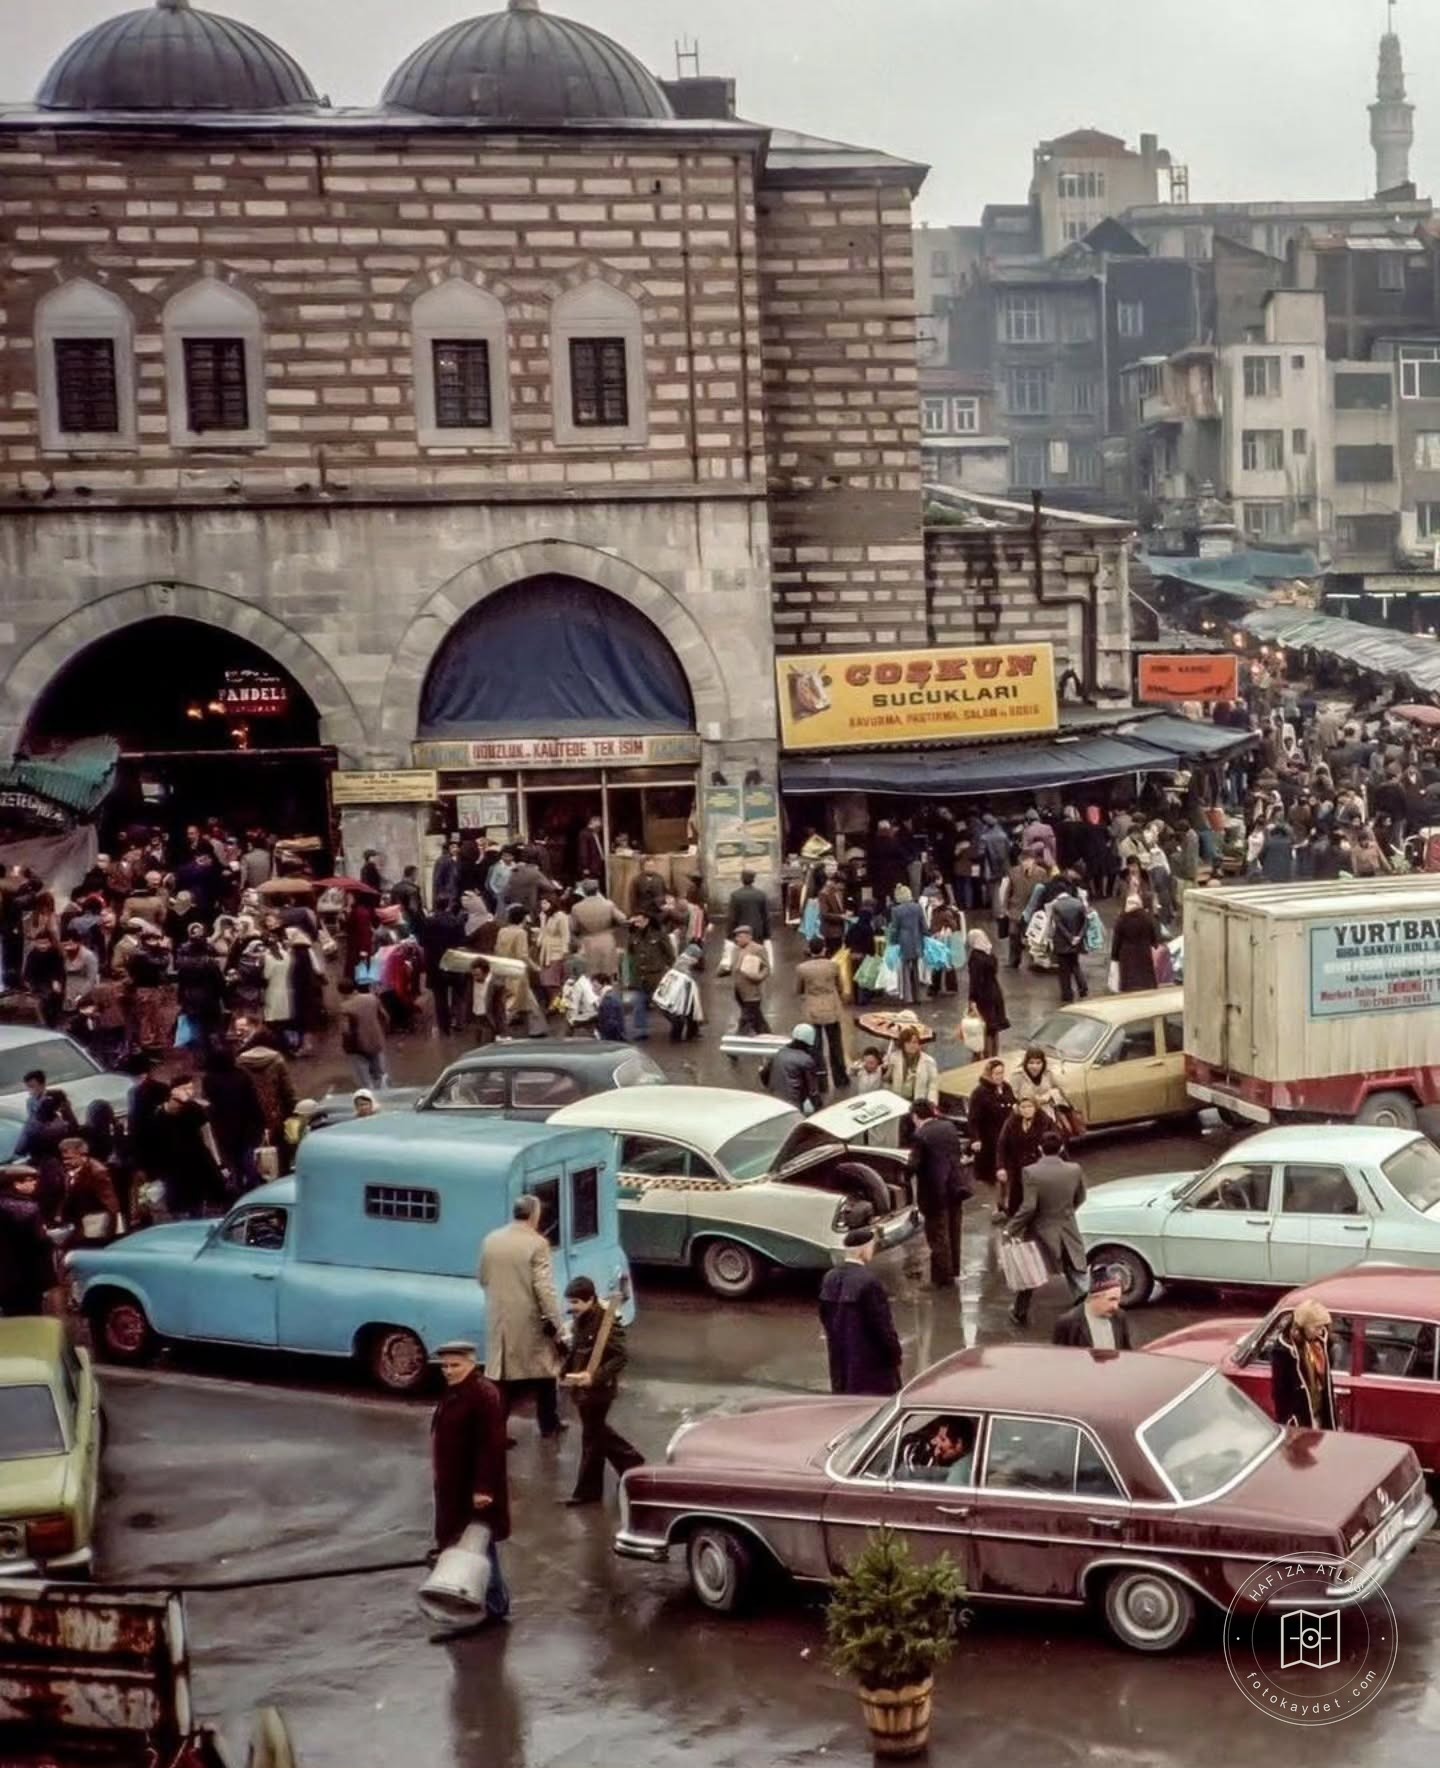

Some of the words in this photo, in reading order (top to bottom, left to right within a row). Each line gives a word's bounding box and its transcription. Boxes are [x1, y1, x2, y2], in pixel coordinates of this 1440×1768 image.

[845, 655, 1037, 690] COŞKUN
[872, 685, 1018, 708] SUCUKLARI
[592, 741, 615, 757] TEK
